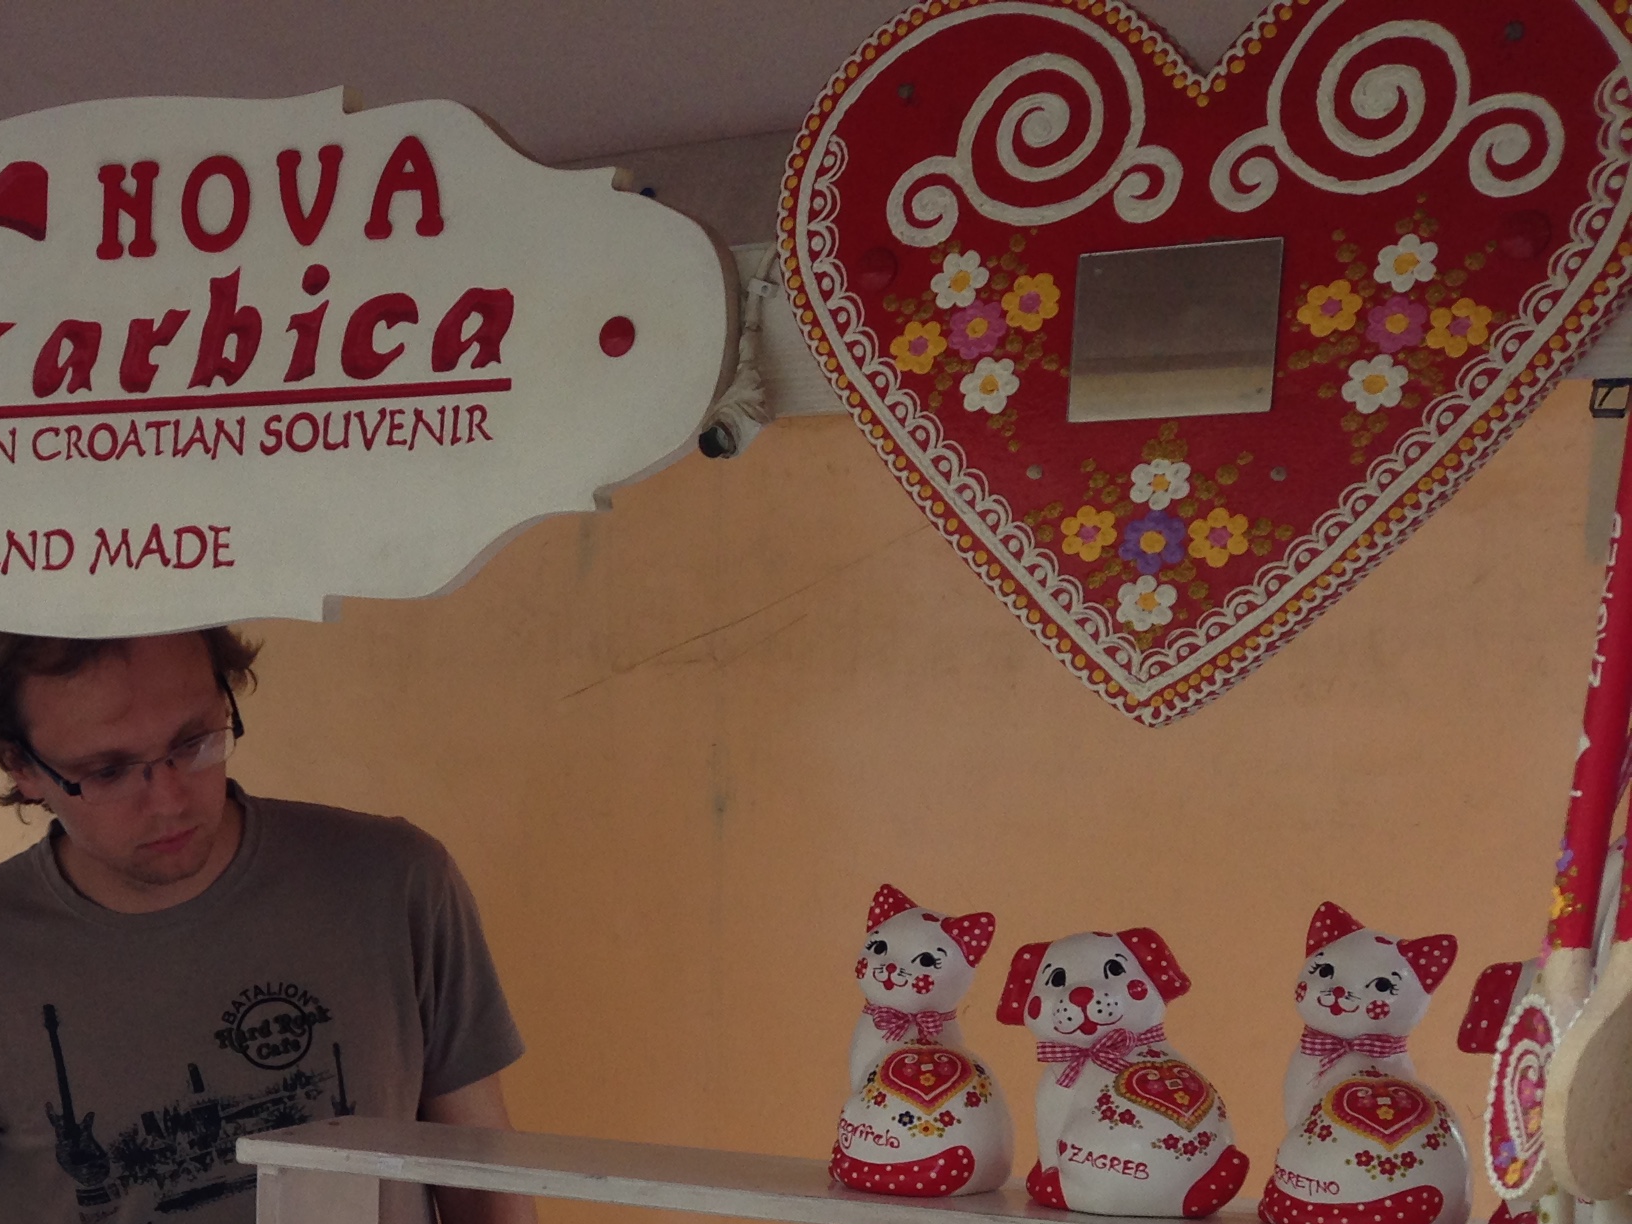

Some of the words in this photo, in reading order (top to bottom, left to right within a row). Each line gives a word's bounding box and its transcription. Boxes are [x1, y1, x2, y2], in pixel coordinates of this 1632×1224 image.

[96, 137, 444, 259] NOVA
[31, 415, 246, 462] CROATIAN
[259, 403, 494, 456] SOUVENIR
[90, 524, 236, 574] MADE
[256, 1036, 302, 1060] Cafe
[1067, 1143, 1150, 1181] ZAGREB
